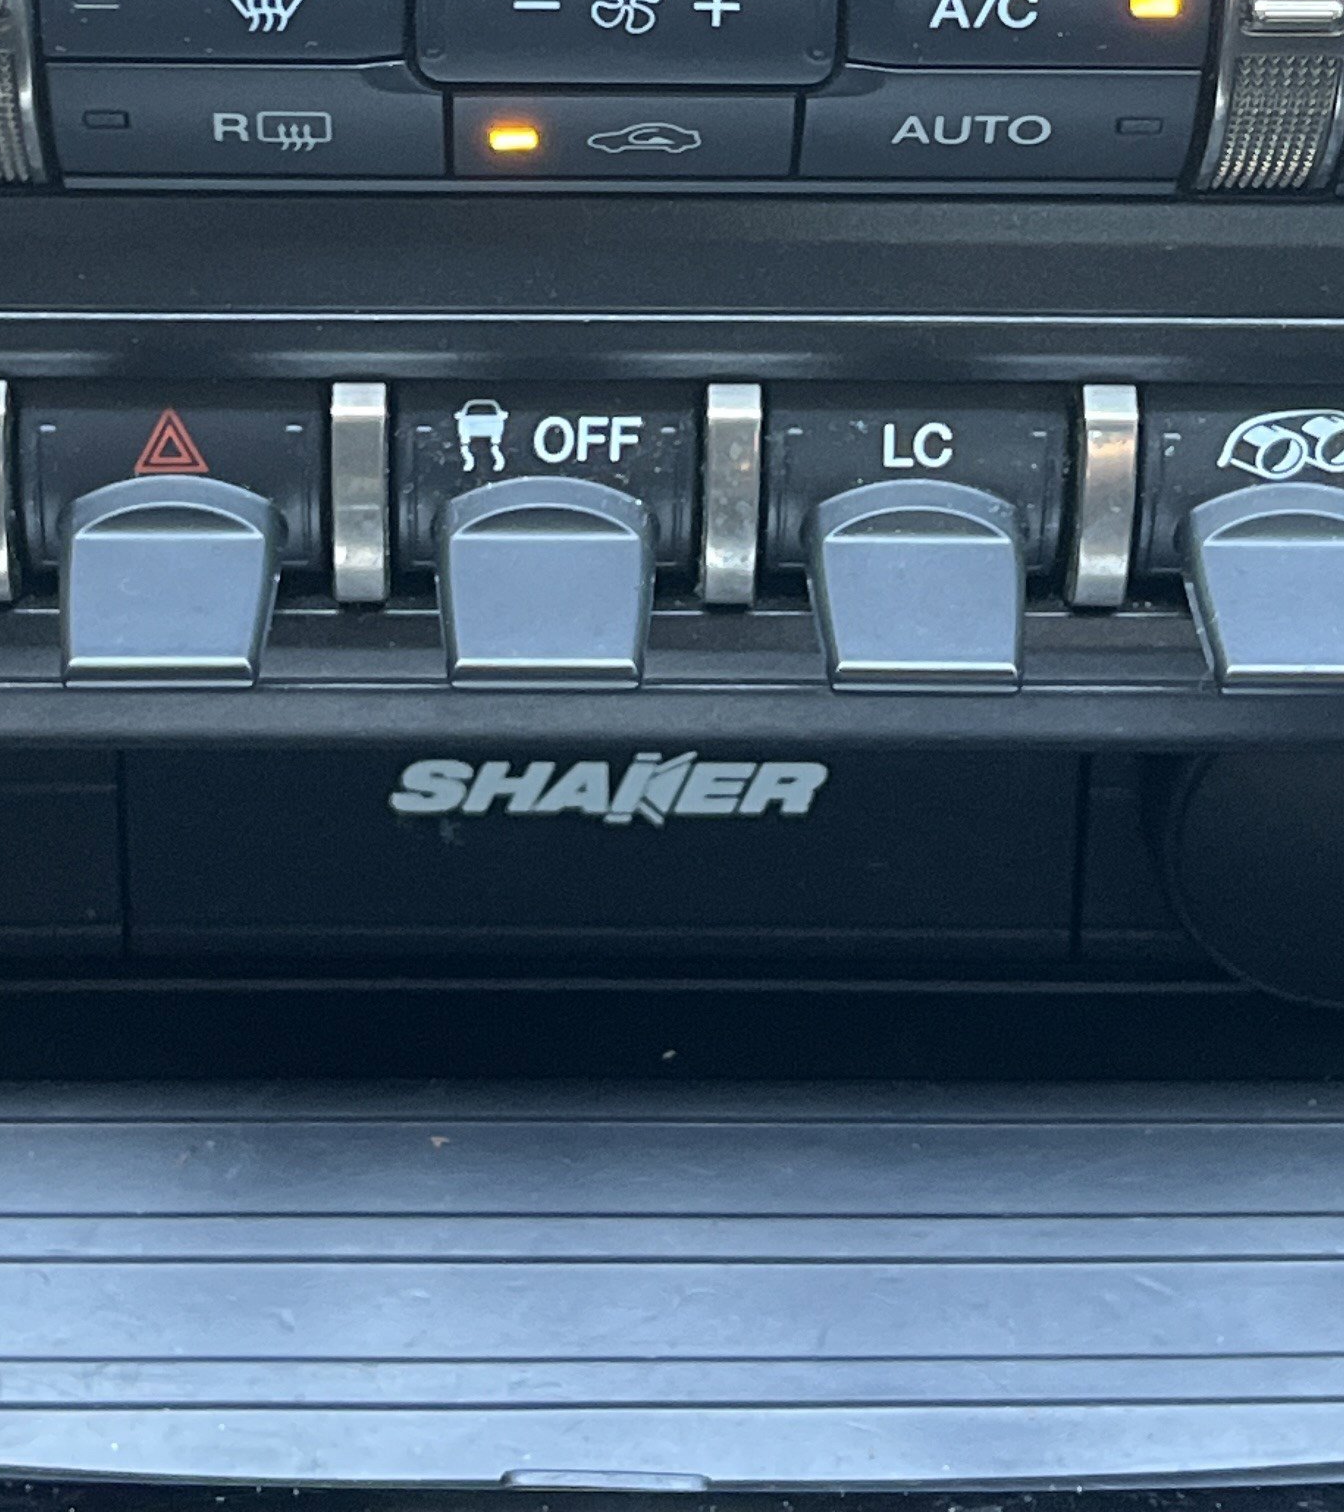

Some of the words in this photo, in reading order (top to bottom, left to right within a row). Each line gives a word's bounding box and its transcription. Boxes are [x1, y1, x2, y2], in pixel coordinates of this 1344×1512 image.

[213, 112, 249, 145] R
[891, 112, 1053, 147] AUTO
[532, 414, 643, 464] OFF
[881, 422, 954, 470] LC
[388, 750, 830, 826] SHAKER
